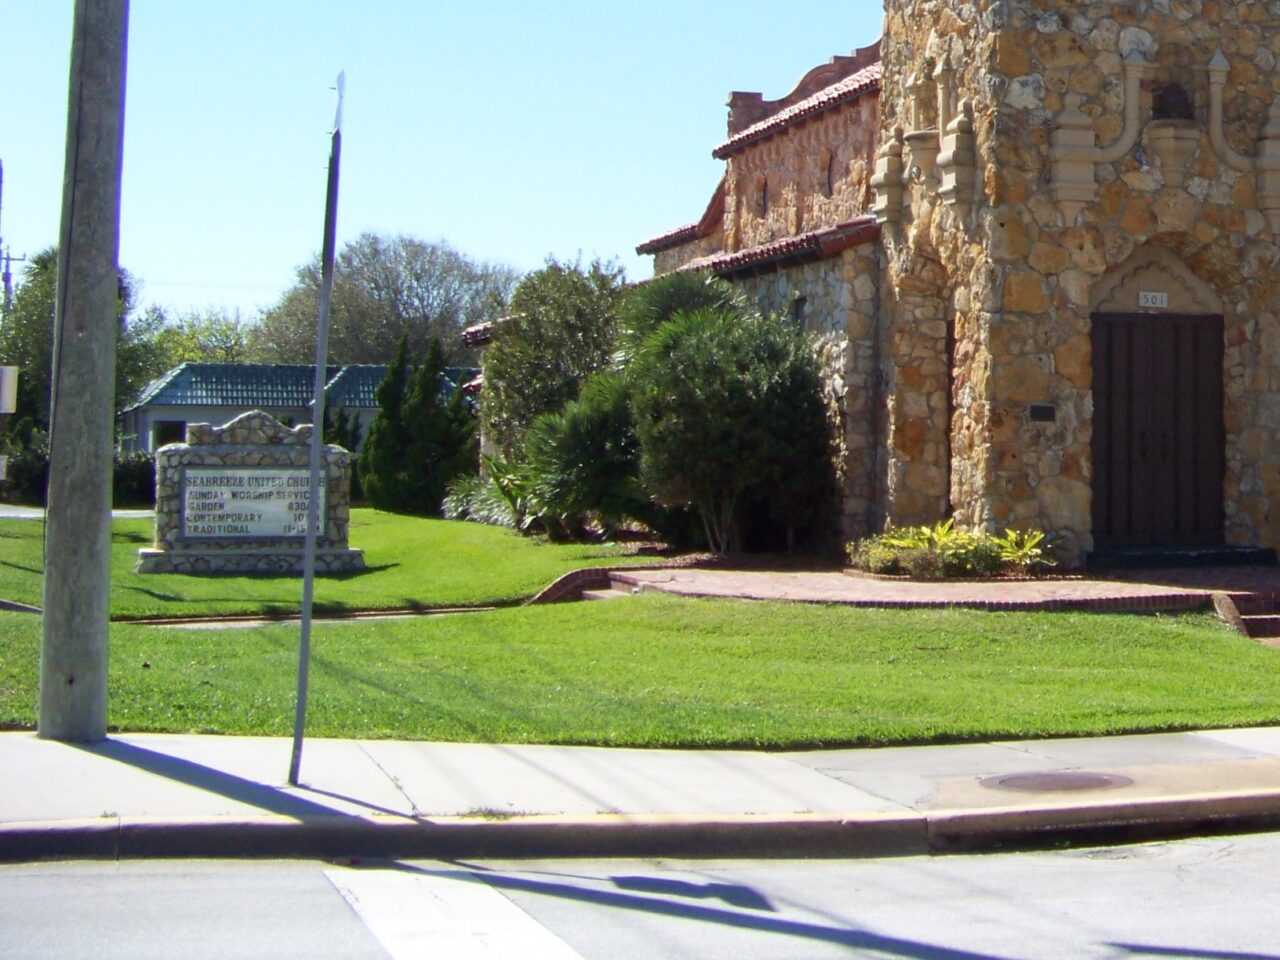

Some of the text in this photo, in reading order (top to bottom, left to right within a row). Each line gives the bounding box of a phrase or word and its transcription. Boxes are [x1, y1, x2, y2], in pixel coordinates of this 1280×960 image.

[1143, 294, 1163, 305] 501
[185, 476, 245, 487] SEABREEZE
[247, 476, 284, 487] UNITED
[189, 490, 226, 500] SUNDAY
[231, 490, 274, 500] WORSHIP
[189, 502, 225, 511] GARDEN
[186, 513, 262, 522] CONTEMPORARY
[187, 524, 252, 534] TRADITIONAL
